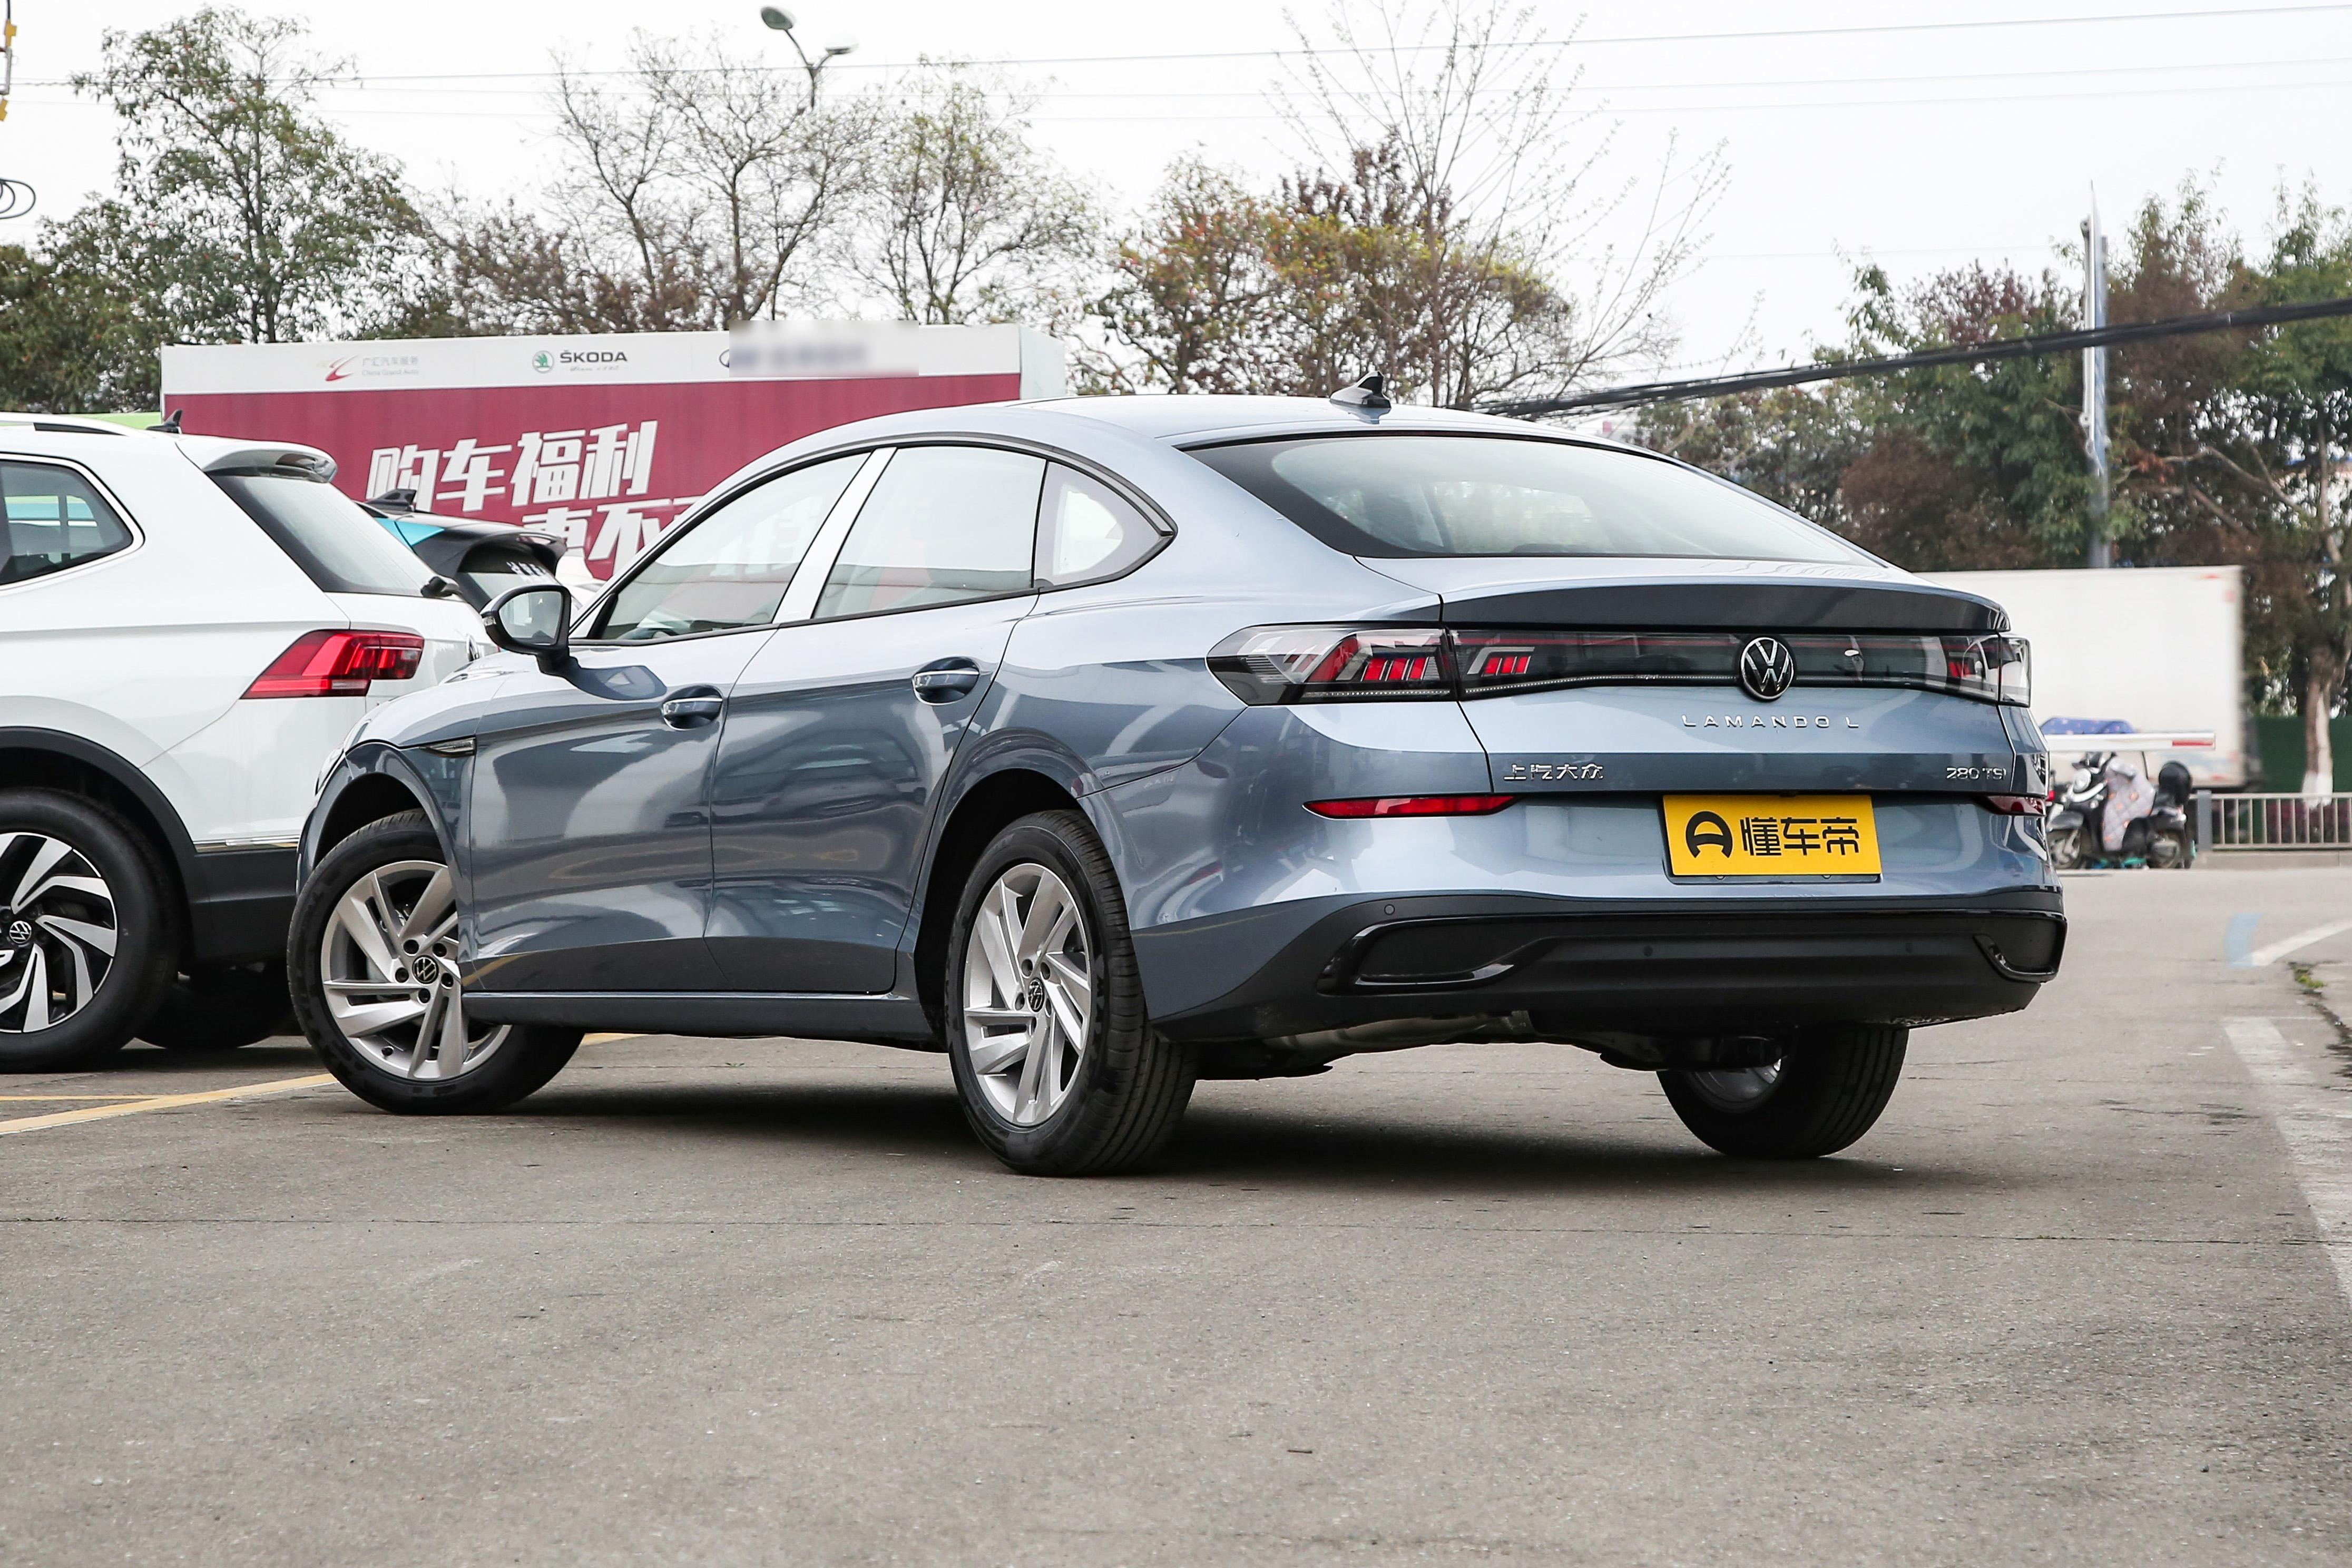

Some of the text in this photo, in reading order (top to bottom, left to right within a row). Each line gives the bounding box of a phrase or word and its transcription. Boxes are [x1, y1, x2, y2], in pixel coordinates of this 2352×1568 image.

[560, 349, 628, 363] ŠKODA
[366, 420, 658, 512] 购车福利
[1681, 714, 1859, 728] LAMANDO L
[1503, 763, 1604, 780] 上汽大众
[1946, 767, 2007, 780] 280 TSI
[1740, 817, 1860, 856] 懂车帝
